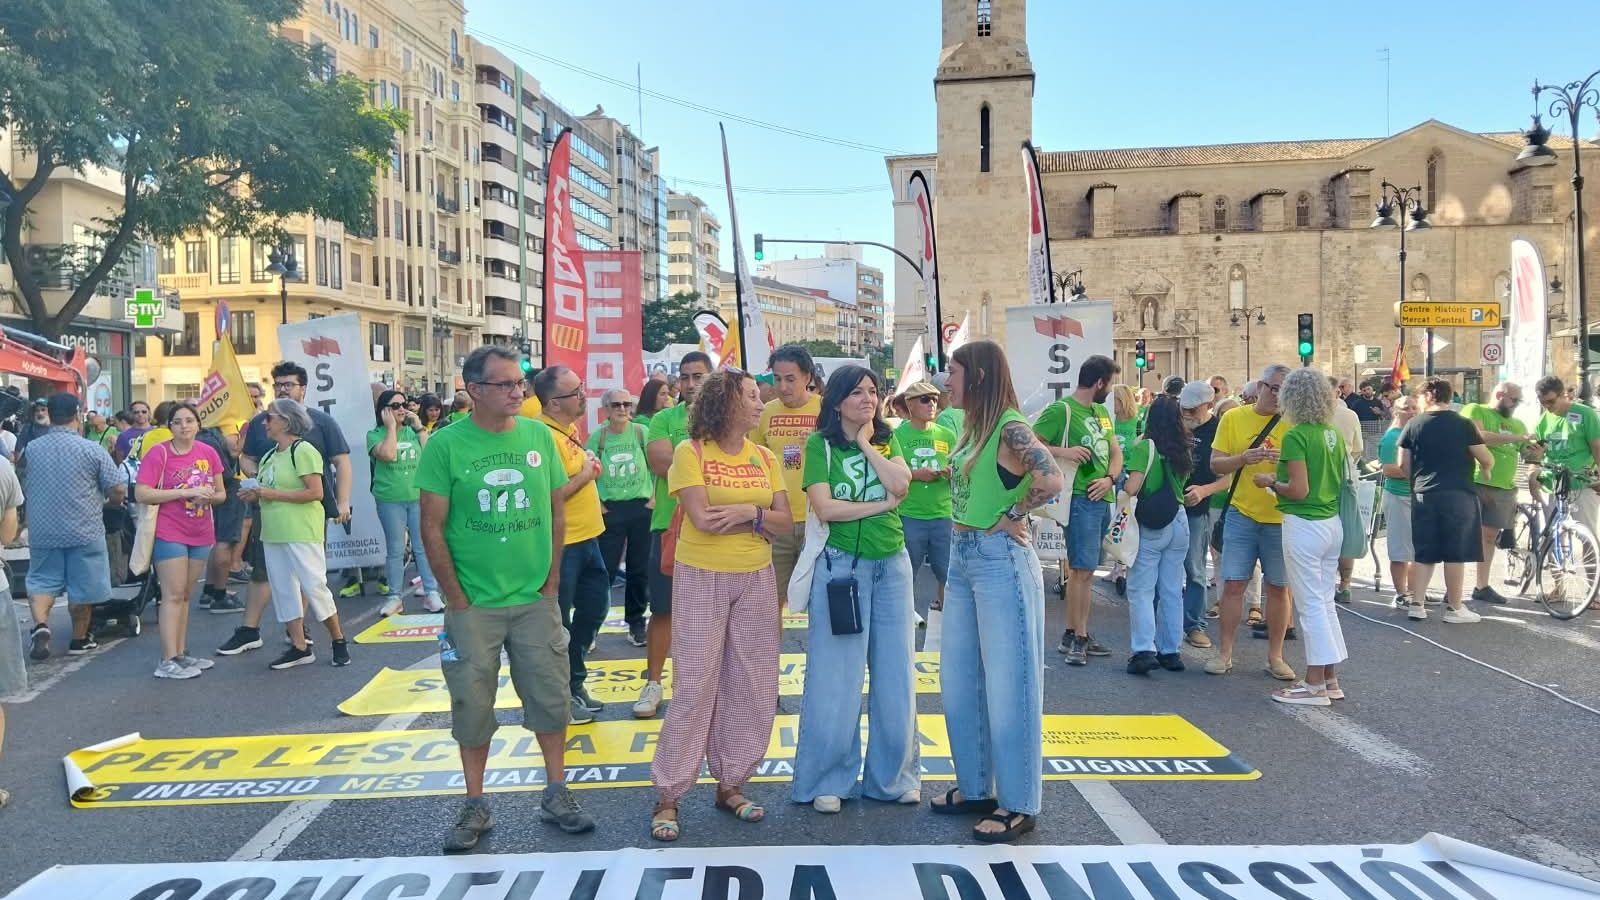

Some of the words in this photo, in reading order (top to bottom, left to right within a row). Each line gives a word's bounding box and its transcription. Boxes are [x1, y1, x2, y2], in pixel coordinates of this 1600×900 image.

[1402, 305, 1430, 313] Centre
[1435, 316, 1467, 324] Central
[82, 749, 240, 774] PER
[339, 772, 424, 792] MÉS
[447, 766, 628, 788] QUALTAT
[1048, 758, 1216, 774] DIGNITAT
